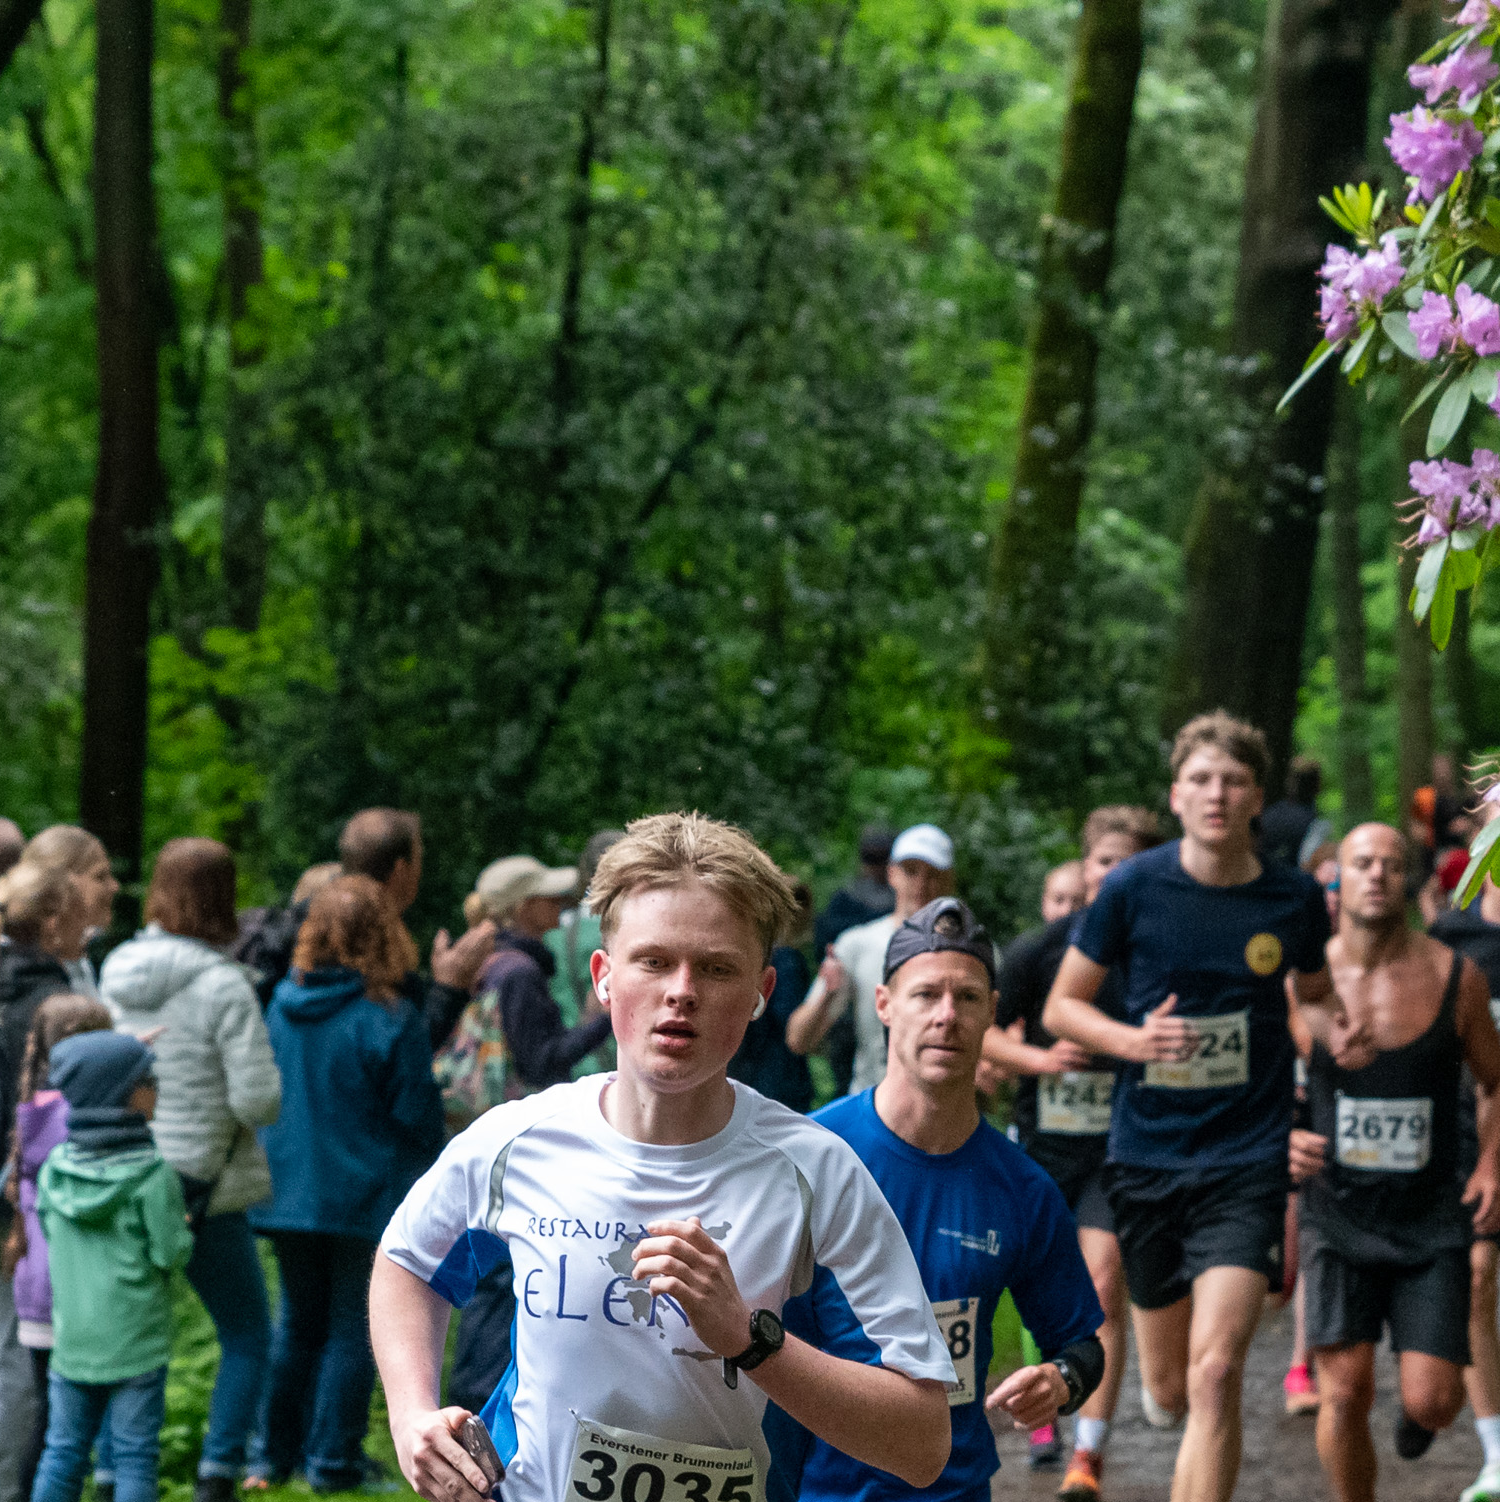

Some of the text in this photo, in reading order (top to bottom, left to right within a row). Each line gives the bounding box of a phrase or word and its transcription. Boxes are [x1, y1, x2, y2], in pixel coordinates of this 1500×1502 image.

[1199, 1029, 1242, 1058] 24
[1342, 1114, 1426, 1140] 2679
[948, 1319, 971, 1360] 8
[591, 1433, 669, 1461] Everstener
